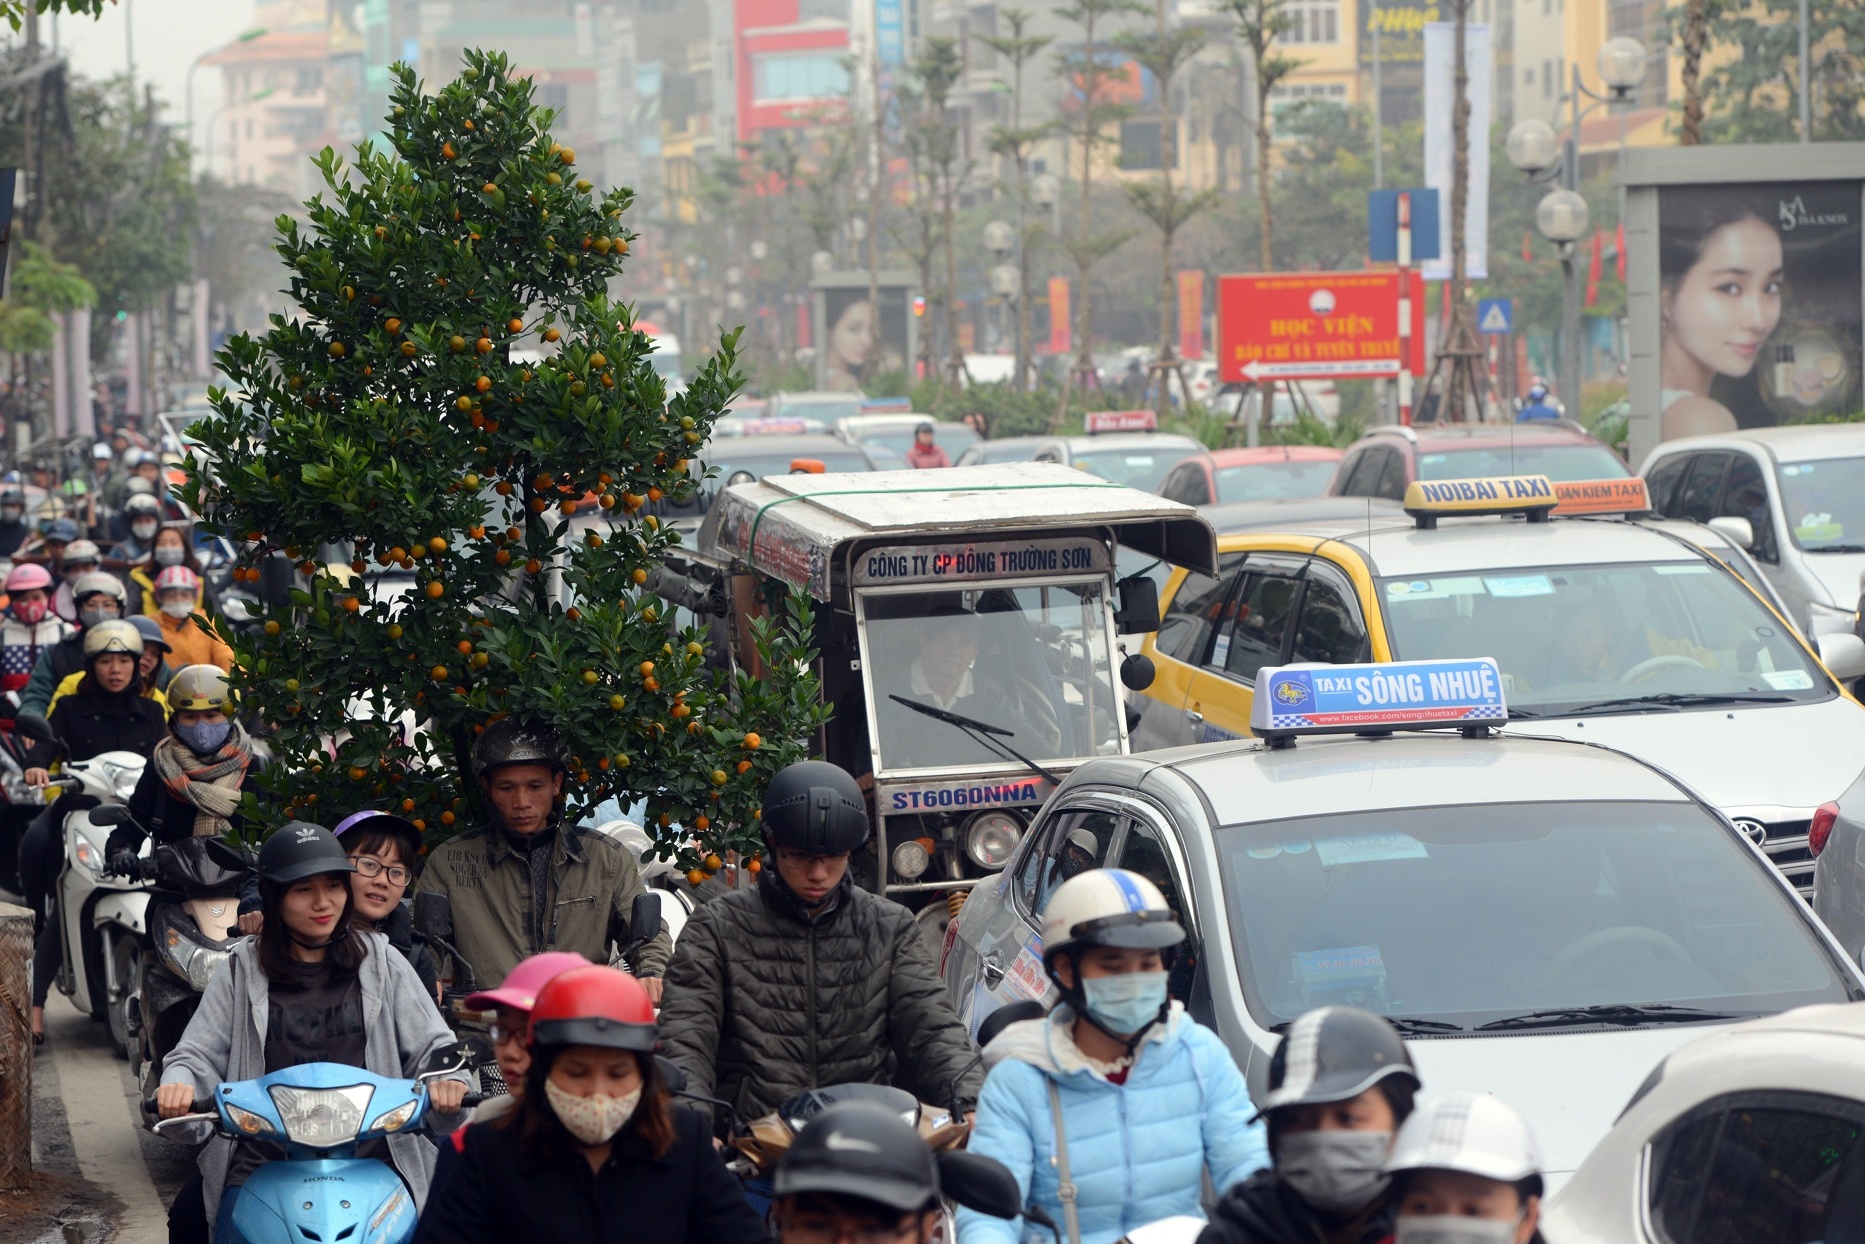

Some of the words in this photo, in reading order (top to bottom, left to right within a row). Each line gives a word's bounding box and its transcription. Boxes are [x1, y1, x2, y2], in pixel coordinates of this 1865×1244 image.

[1270, 318, 1315, 339] HỌC
[1323, 313, 1374, 339] VIỆN
[1500, 478, 1552, 499] TAXI
[1613, 484, 1642, 496] TAXI
[868, 552, 907, 578] CÔNG
[912, 554, 929, 576] TY
[933, 554, 951, 574] CP
[956, 548, 996, 573] ĐÔNG
[1000, 544, 1059, 571] TRƯỜNG
[1062, 547, 1092, 569] SƠN
[1315, 677, 1352, 691] TAXI
[1355, 670, 1424, 706] SÔNG
[1429, 663, 1497, 704] NHUỆ
[1319, 709, 1458, 723] www.facebook.com/songnhuetaxi
[892, 783, 1037, 809] ST6060NNA
[297, 835, 320, 844] adidas
